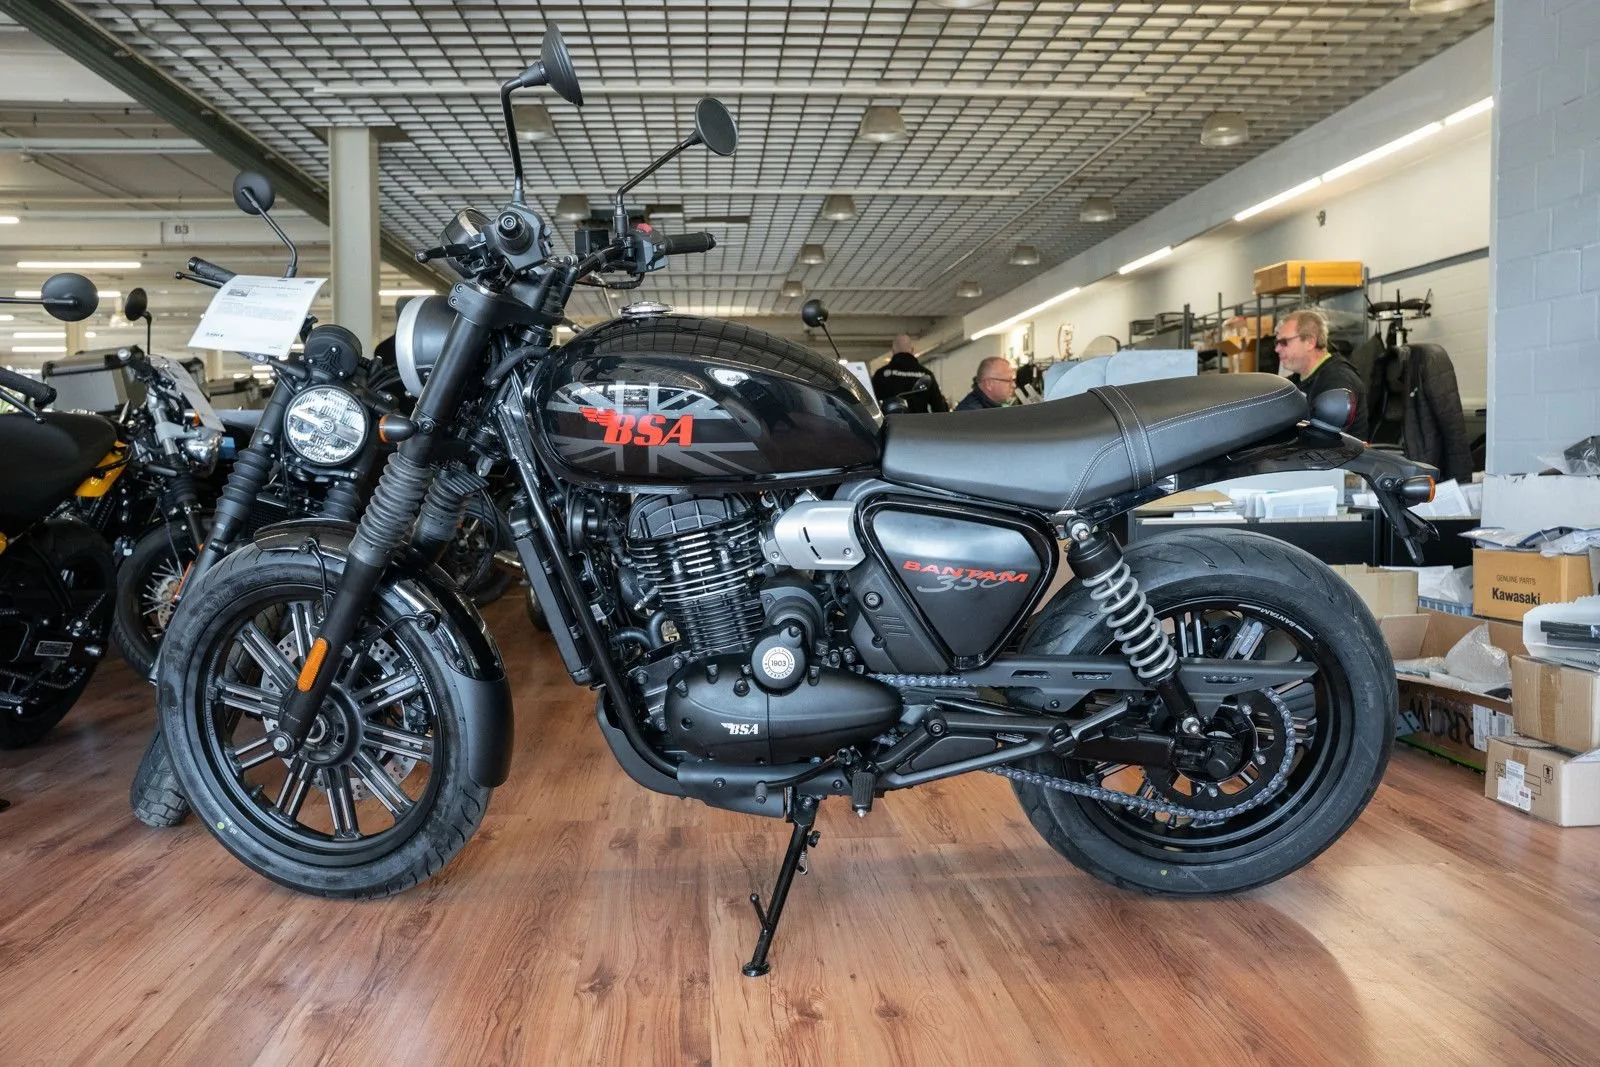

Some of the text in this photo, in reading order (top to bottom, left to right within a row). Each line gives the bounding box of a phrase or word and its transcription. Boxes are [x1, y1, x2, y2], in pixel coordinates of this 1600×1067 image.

[602, 413, 695, 447] BSA
[903, 560, 1029, 583] BANTAM
[1496, 574, 1537, 586] GENUINE PARTS
[1492, 587, 1541, 606] Kawasaki
[1260, 608, 1297, 627] BANTAM
[771, 659, 787, 667] 1903
[728, 723, 759, 735] BSA
